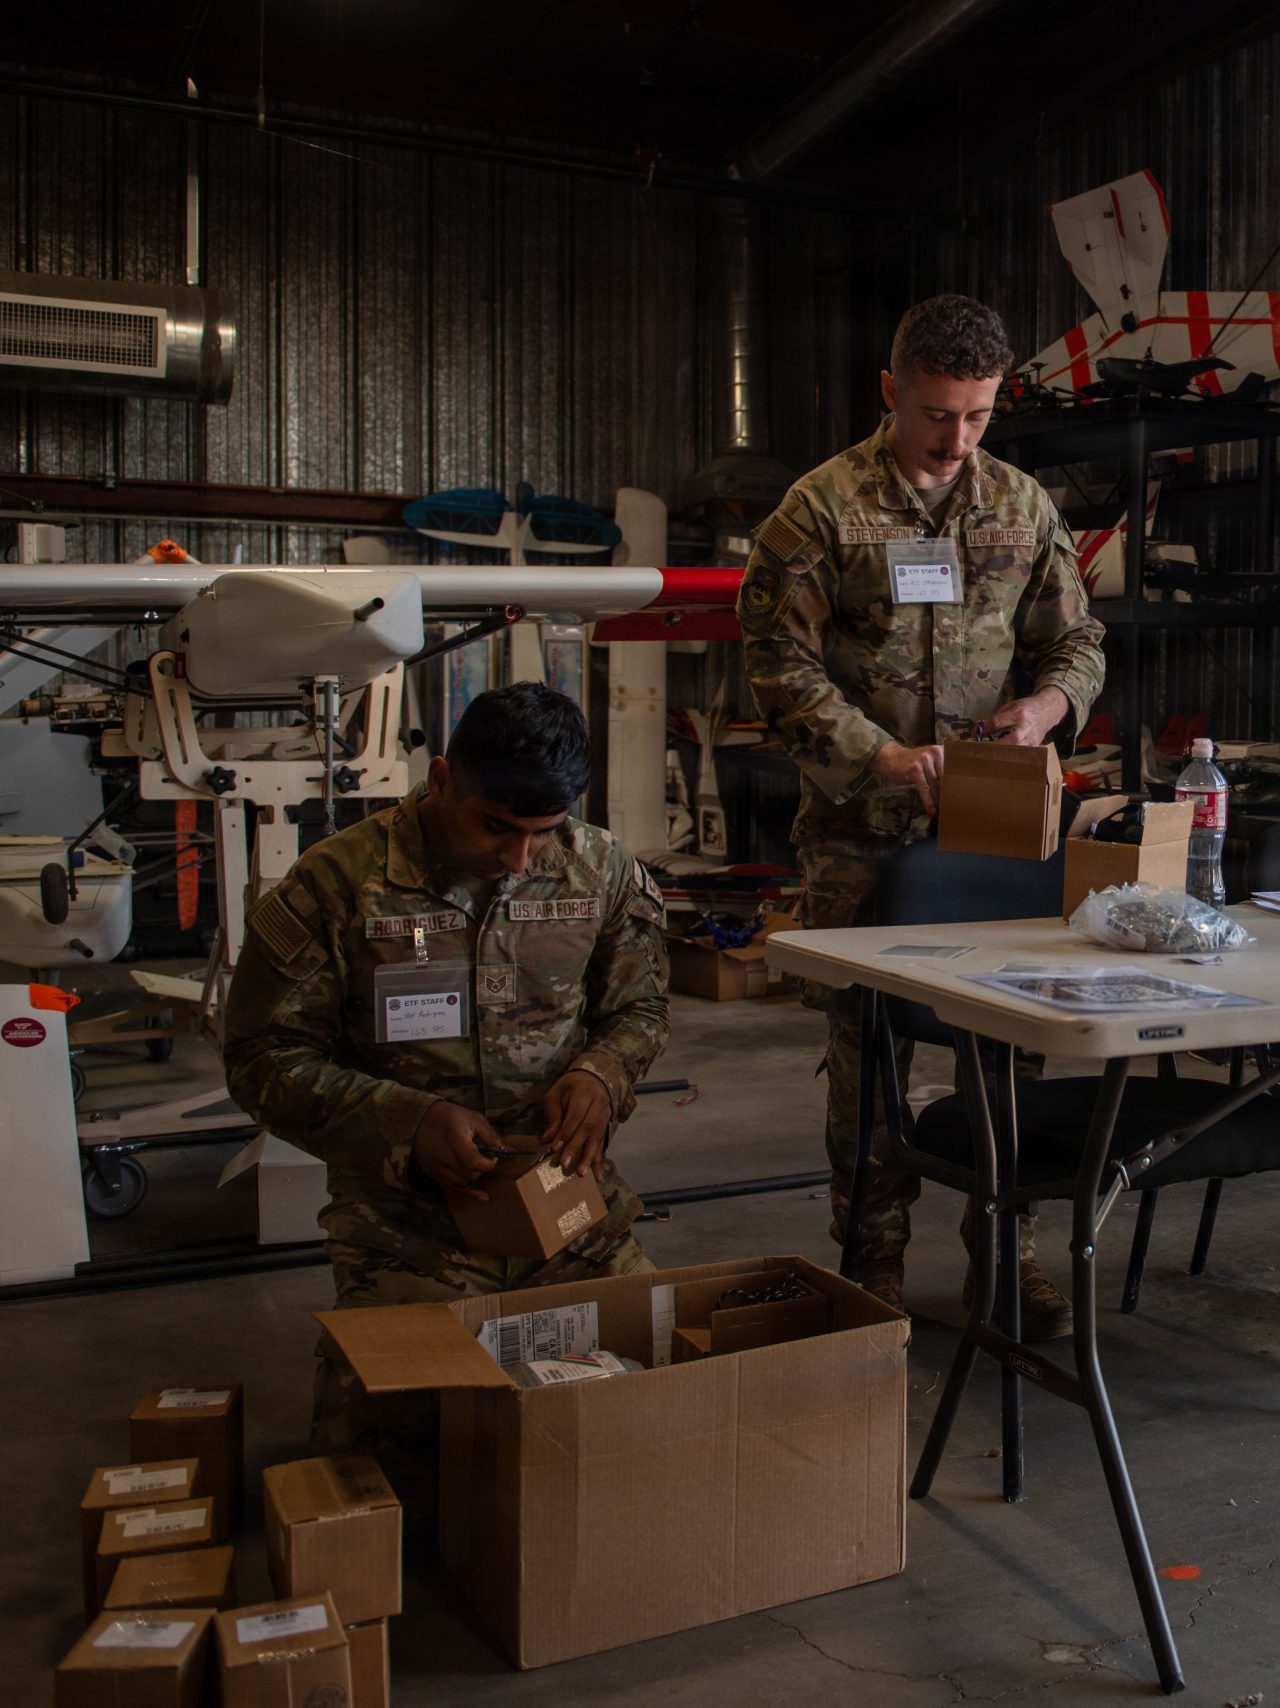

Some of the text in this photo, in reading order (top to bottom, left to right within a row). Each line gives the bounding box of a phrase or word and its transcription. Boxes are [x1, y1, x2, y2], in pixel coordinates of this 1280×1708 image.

[846, 528, 911, 541] STEVENSON
[989, 530, 1005, 544] AIR
[1006, 530, 1034, 544] FORCE
[535, 903, 553, 918] AIR
[556, 901, 595, 917] FORCE
[374, 913, 458, 936] RODRIGUEZ
[404, 997, 445, 1007] ETF STAFF
